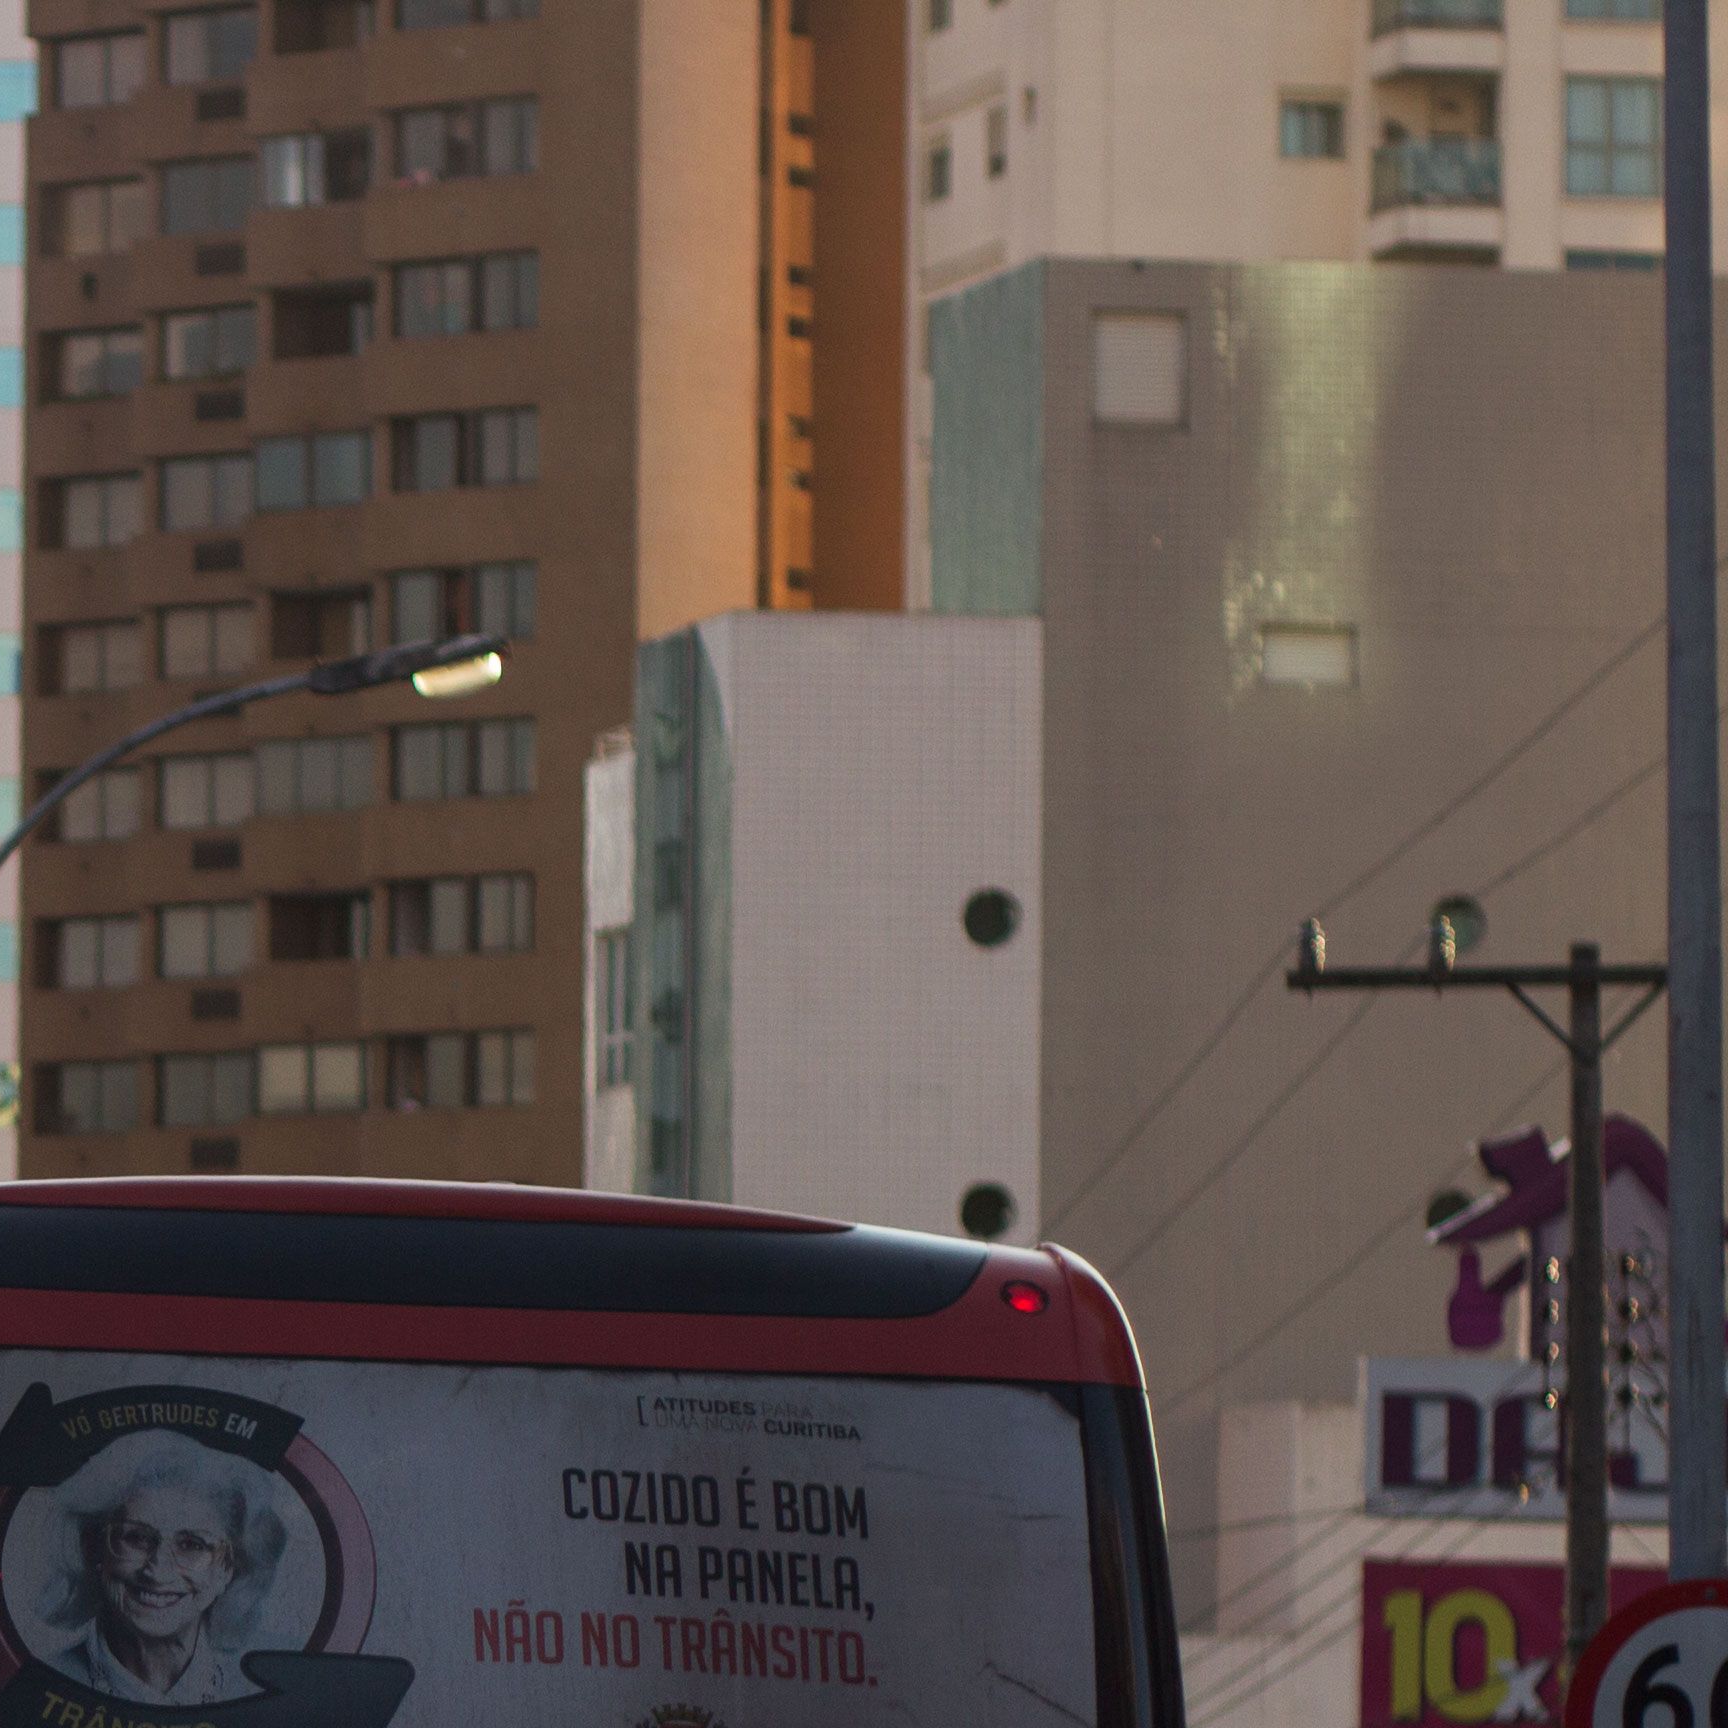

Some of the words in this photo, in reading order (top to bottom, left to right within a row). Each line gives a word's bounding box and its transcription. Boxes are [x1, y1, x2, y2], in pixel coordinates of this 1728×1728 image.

[61, 1408, 93, 1440] VÓ
[98, 1402, 220, 1430] GERTRUDES
[224, 1412, 258, 1440] EM
[653, 1396, 756, 1416] ATITUDES
[763, 1418, 861, 1440] CURITIBA
[562, 1468, 721, 1528] COZIDO
[738, 1466, 760, 1531] É
[775, 1479, 870, 1540] BOM
[624, 1541, 682, 1598] NA
[699, 1546, 875, 1621] PANELA,
[473, 1599, 564, 1666] NÃO
[581, 1614, 642, 1668] NO
[654, 1606, 878, 1688] TRÂNSITO.
